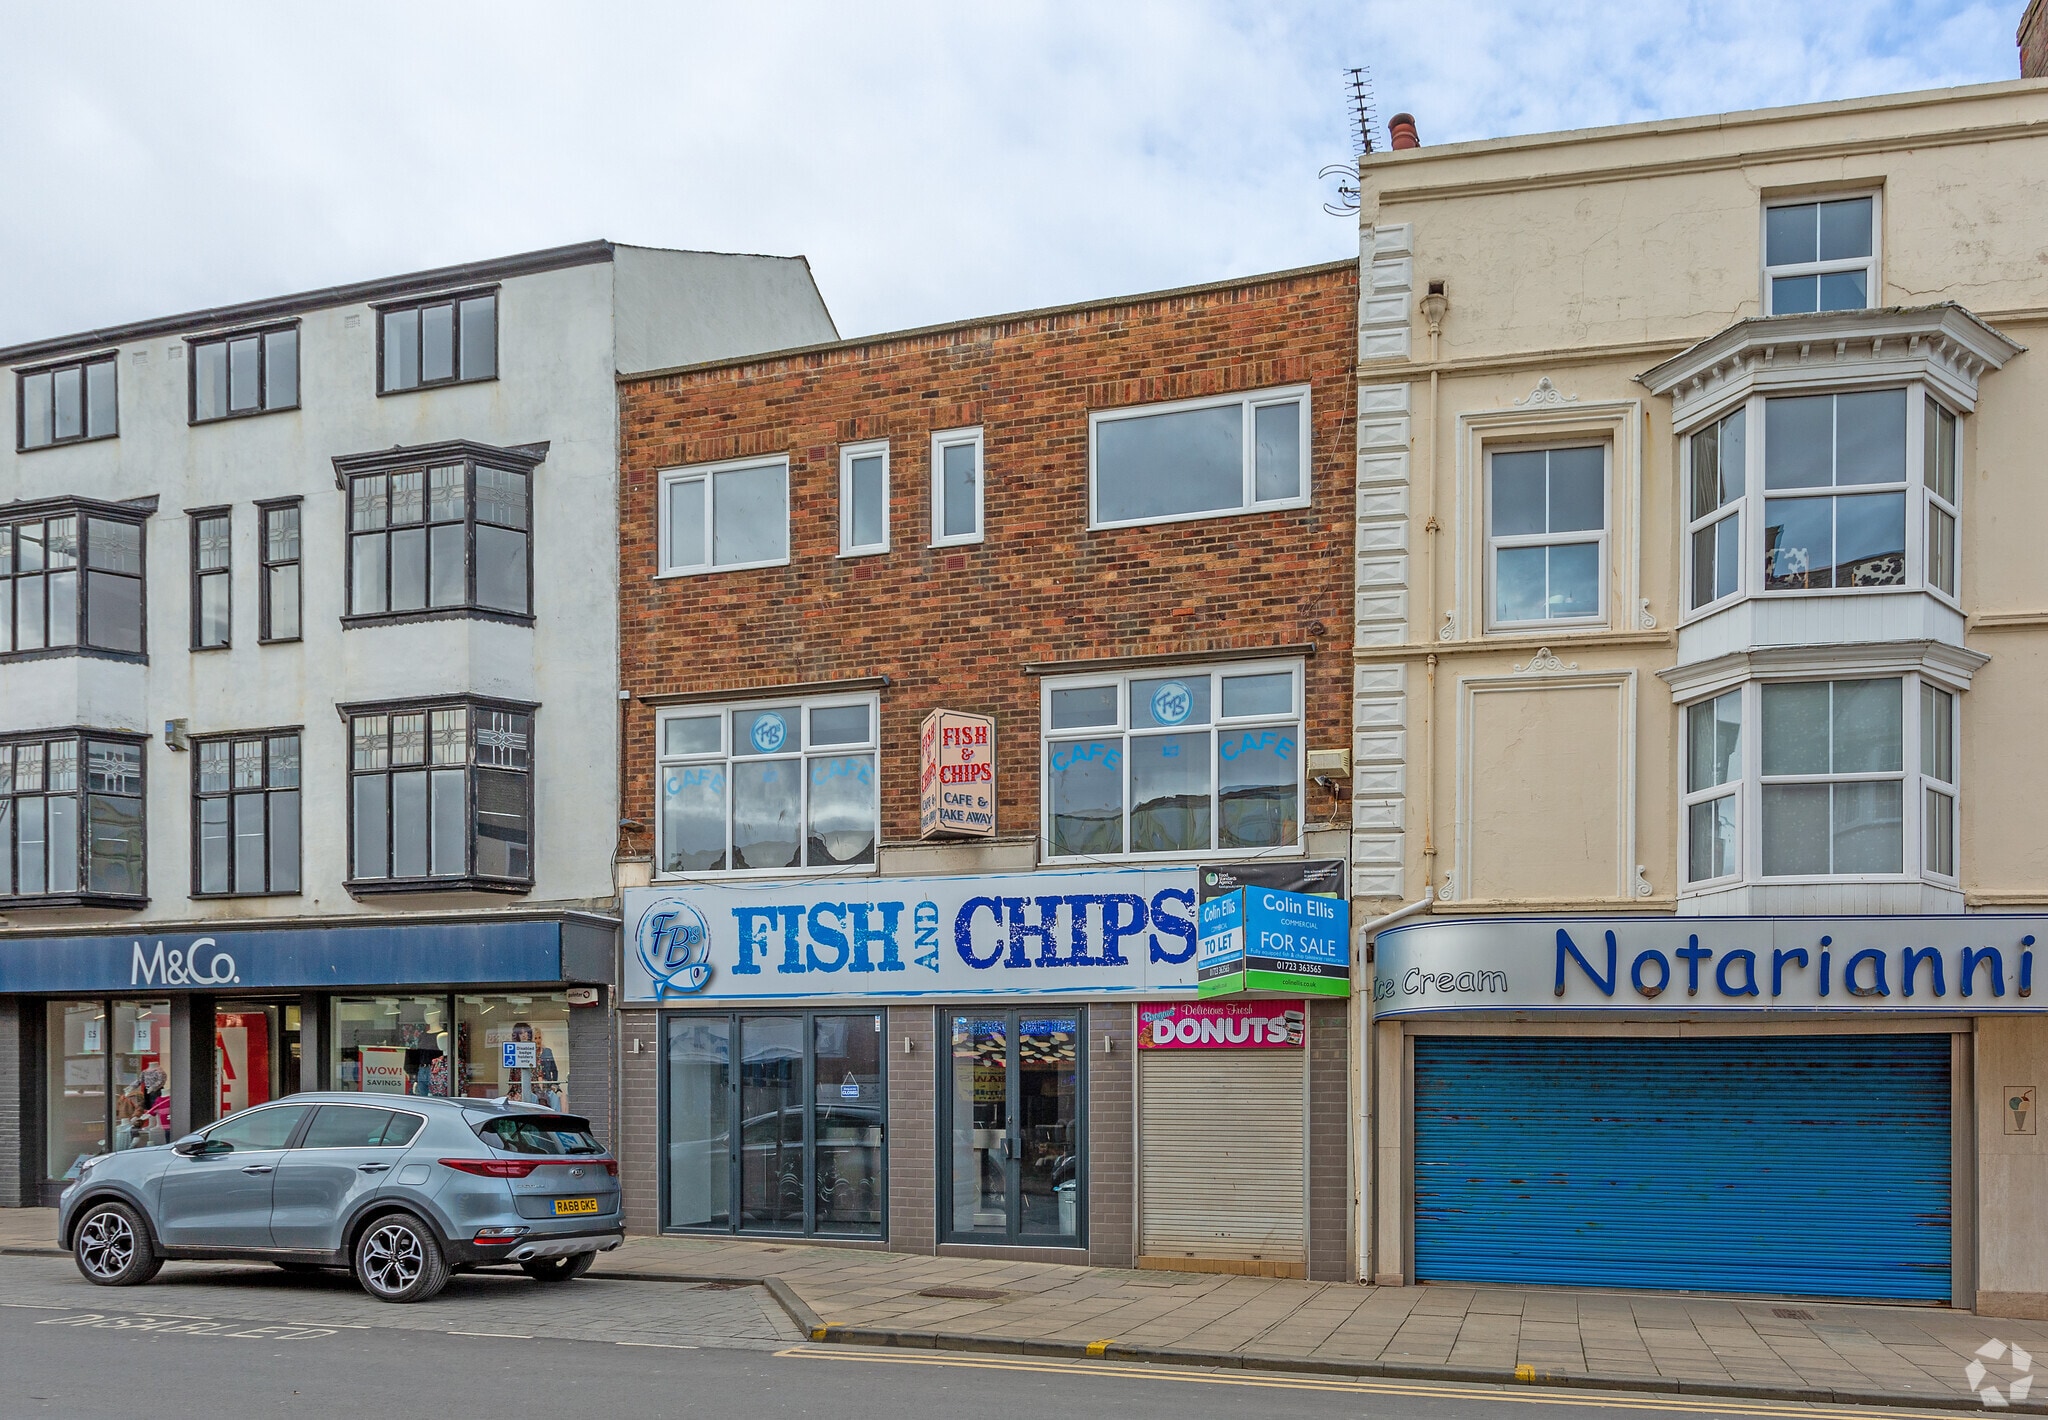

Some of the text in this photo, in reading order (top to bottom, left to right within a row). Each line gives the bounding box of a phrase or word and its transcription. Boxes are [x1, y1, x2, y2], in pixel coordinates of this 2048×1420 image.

[942, 726, 988, 748] FISH
[1221, 732, 1294, 761] CAFE
[961, 748, 974, 761] &
[1052, 743, 1121, 771] CAFE
[667, 768, 725, 795] CAFE
[811, 758, 875, 786] CAFE
[939, 763, 992, 784] CHIPS
[944, 792, 988, 807] CAFE &
[938, 808, 993, 824] TAKE AWAY
[1204, 898, 1236, 923] Colin Ellis
[1263, 893, 1334, 919] Colin Ellis
[954, 887, 1196, 969] CHIPS
[1280, 918, 1318, 930] COMMERCIAL
[731, 901, 905, 975] FISH
[913, 900, 939, 973] AND
[1204, 932, 1233, 956] TO LET
[1260, 931, 1336, 957] FOR SALE
[131, 937, 240, 985] M&Co.
[1276, 960, 1322, 974] 01723 363565
[1554, 928, 2036, 999] Notarianni
[1282, 979, 1317, 988] colinellis.co.uk
[1372, 967, 1508, 1003] Ice Cream
[1181, 1003, 1253, 1016] Delicious Fresh
[88, 1030, 97, 1038] £5
[138, 1030, 147, 1038] £5
[1152, 1017, 1288, 1044] DONUTS
[506, 1044, 515, 1054] P
[365, 1066, 403, 1076] WOW!
[366, 1079, 402, 1087] SAVINGS
[556, 1199, 597, 1213] RA68 GKE
[35, 1313, 338, 1340] DISABLED
